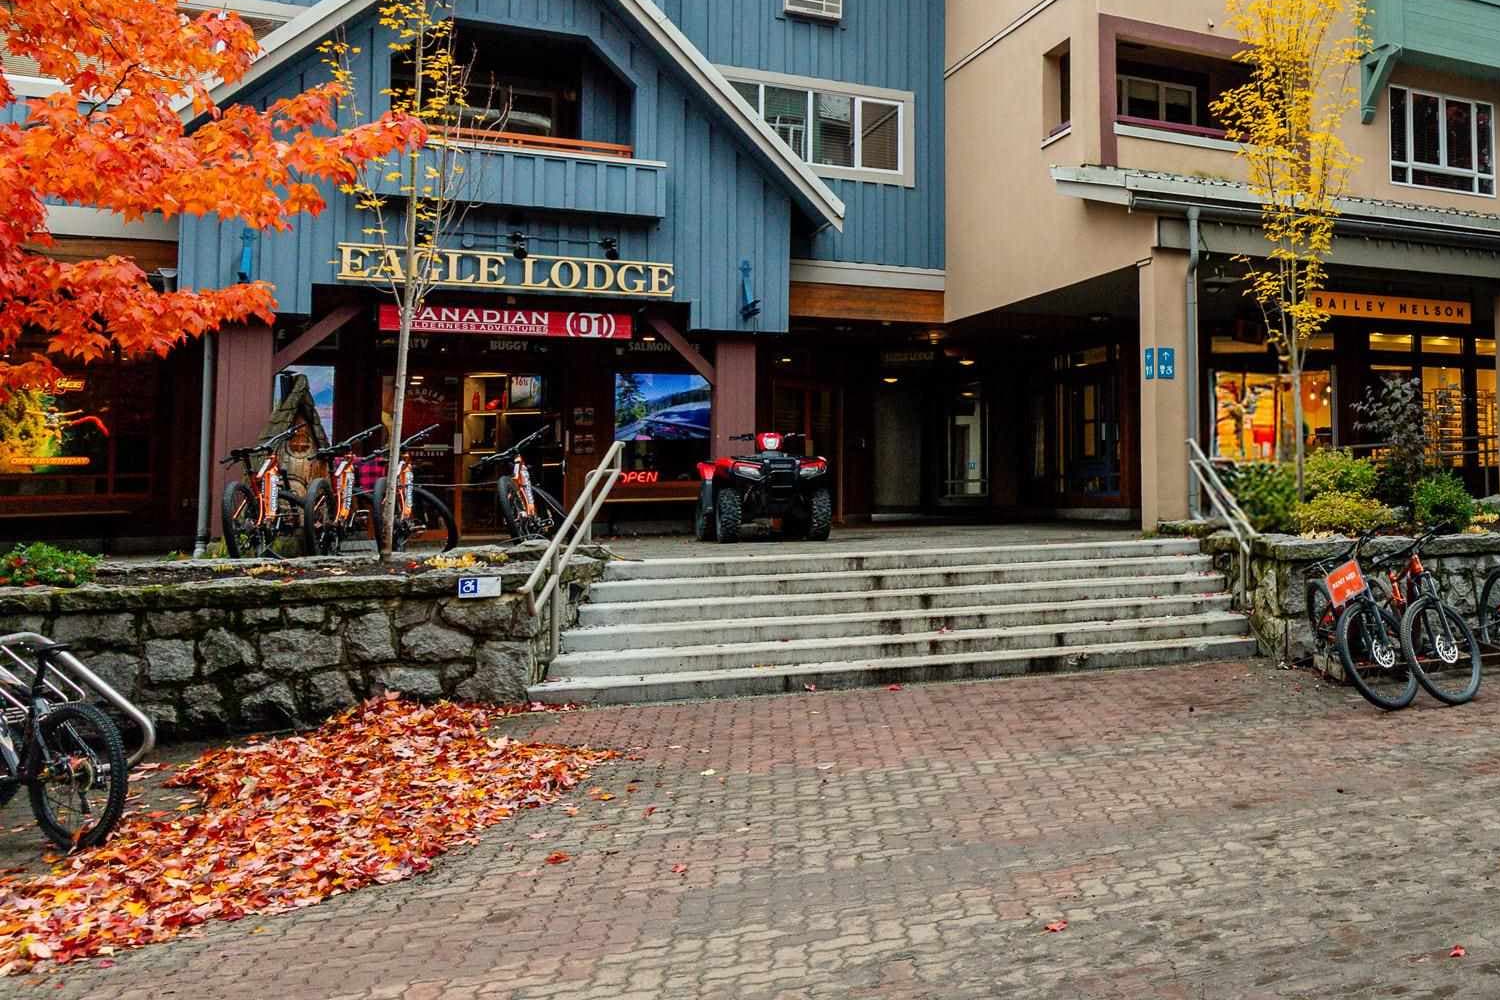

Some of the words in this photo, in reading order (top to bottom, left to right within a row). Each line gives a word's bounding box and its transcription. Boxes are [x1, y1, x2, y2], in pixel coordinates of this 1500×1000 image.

[337, 245, 506, 285] EAGLE
[520, 257, 675, 294] LODGE
[1315, 297, 1386, 312] BAILEY
[1400, 303, 1464, 318] NELSON
[401, 319, 477, 331] ILDERNESS
[490, 340, 529, 351] BUGGY
